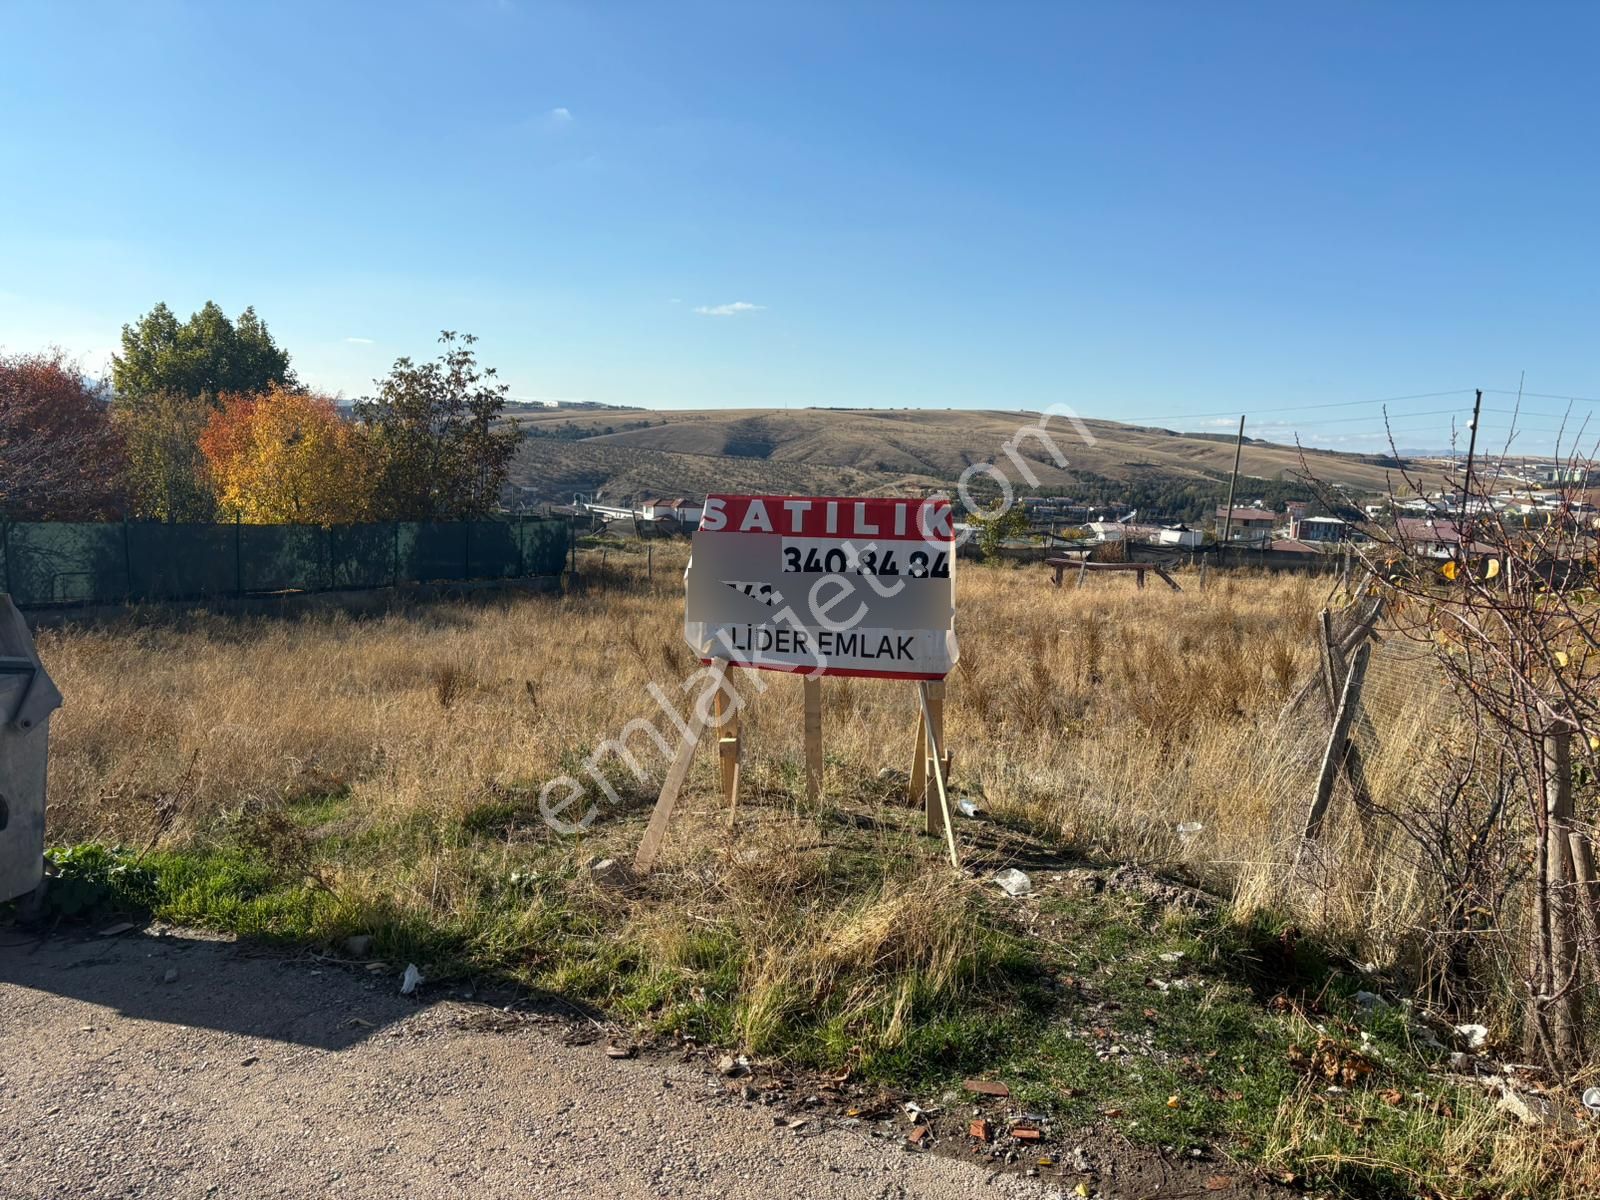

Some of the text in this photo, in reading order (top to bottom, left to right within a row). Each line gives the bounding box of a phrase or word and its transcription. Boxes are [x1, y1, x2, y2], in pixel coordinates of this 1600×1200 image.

[700, 497, 952, 537] SATILIK
[783, 546, 847, 573] 340
[731, 624, 915, 661] LİDER EMLAK
